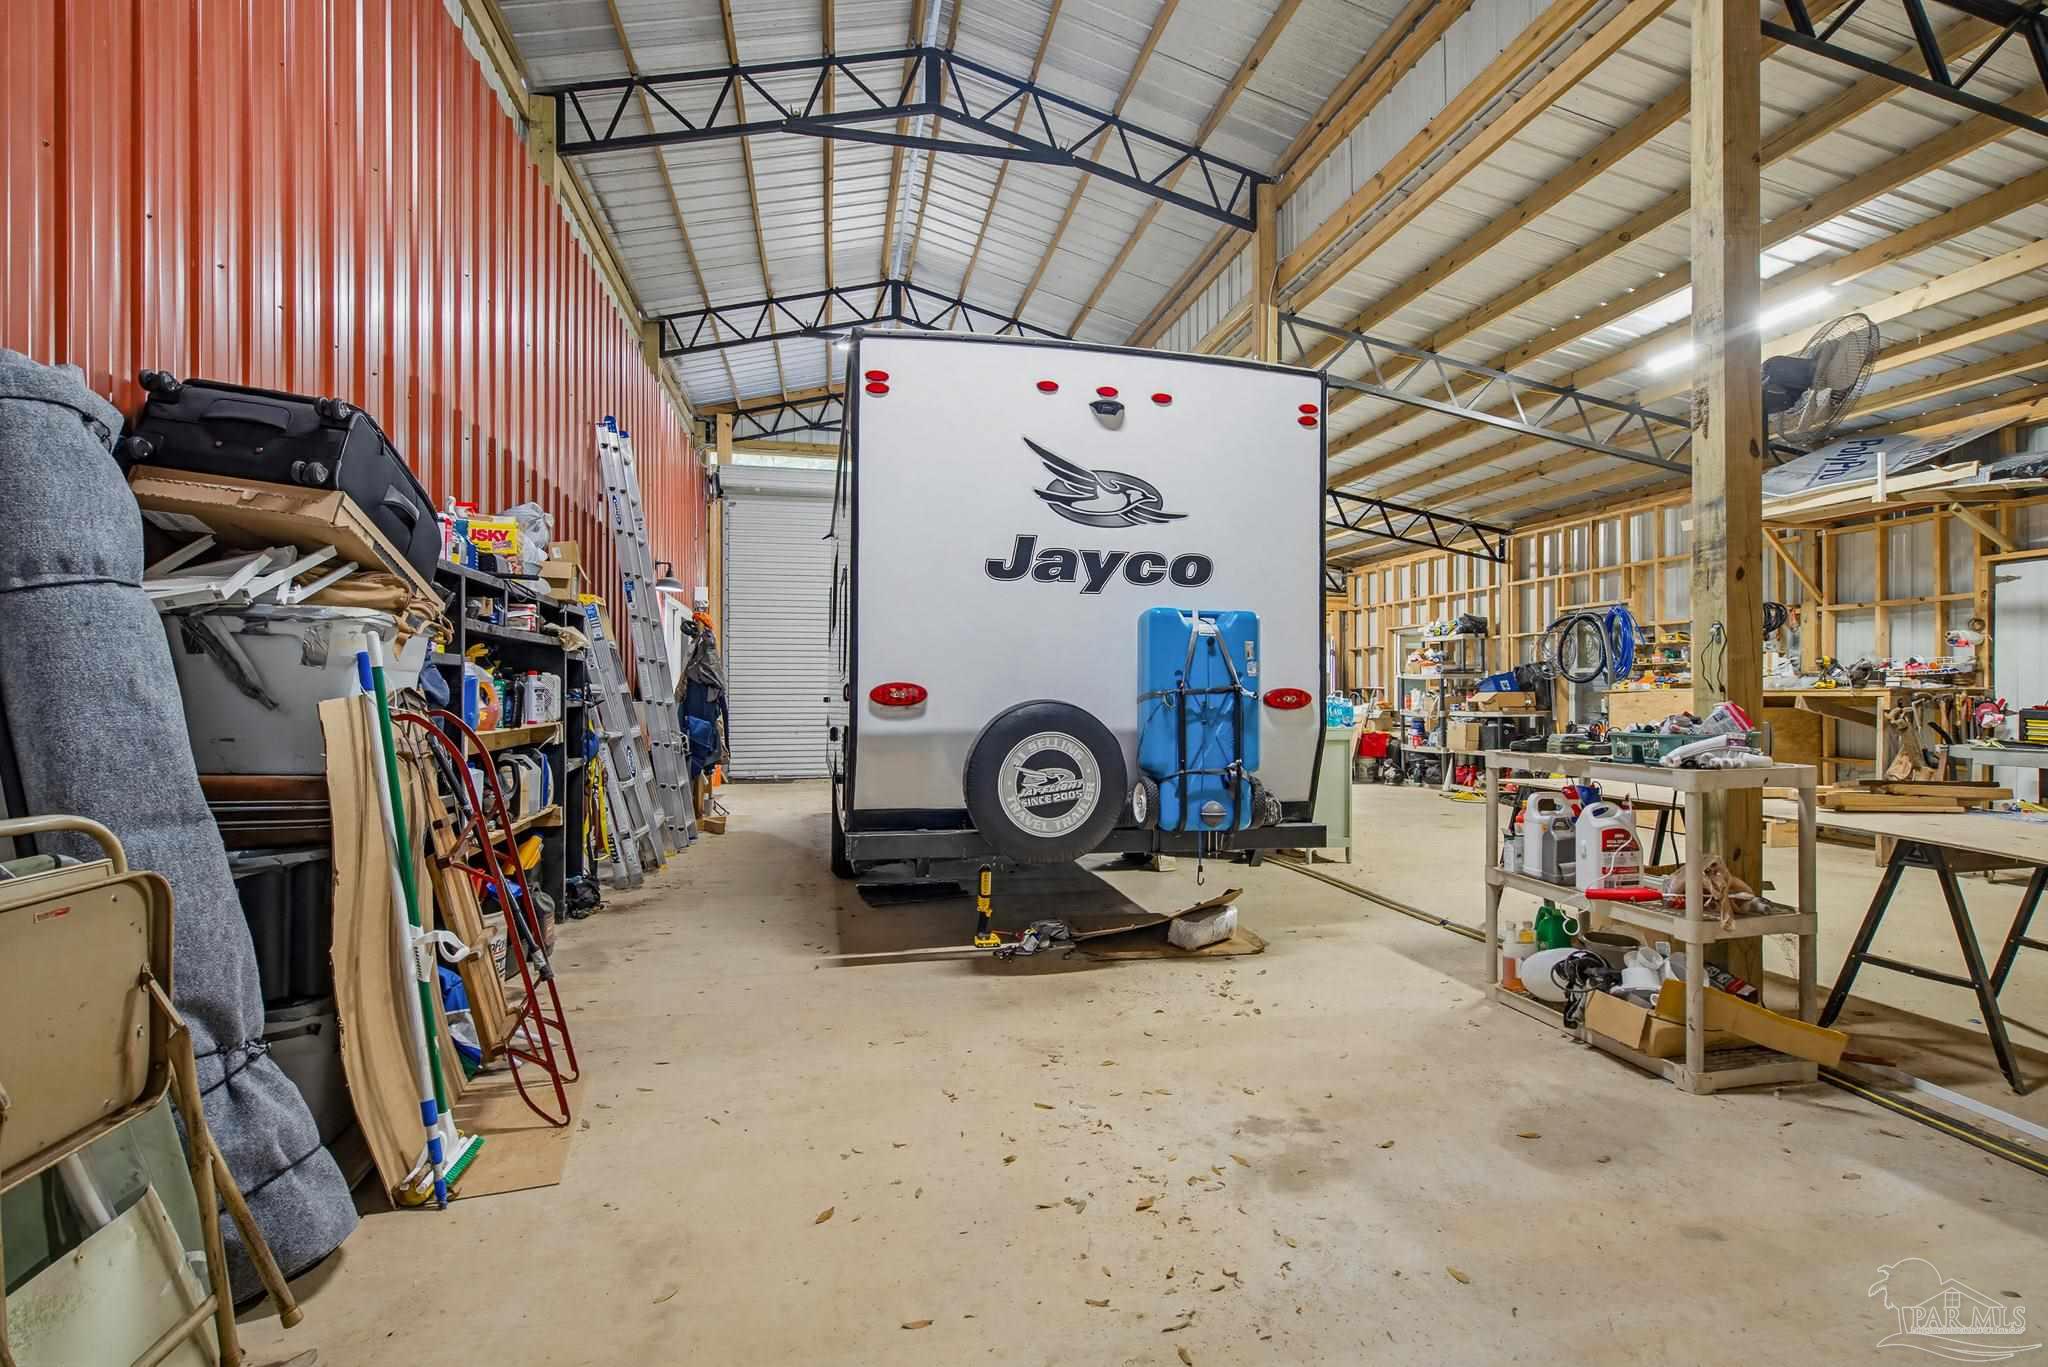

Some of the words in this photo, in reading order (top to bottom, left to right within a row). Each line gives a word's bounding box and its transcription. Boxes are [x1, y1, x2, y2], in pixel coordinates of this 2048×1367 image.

[985, 534, 1213, 594] Jayco
[1028, 737, 1083, 761] SELLING
[1007, 797, 1047, 831] TRAVEL
[1056, 781, 1096, 832] TRAILER
[1021, 793, 1052, 807] SINCE
[1053, 789, 1084, 803] 2005
